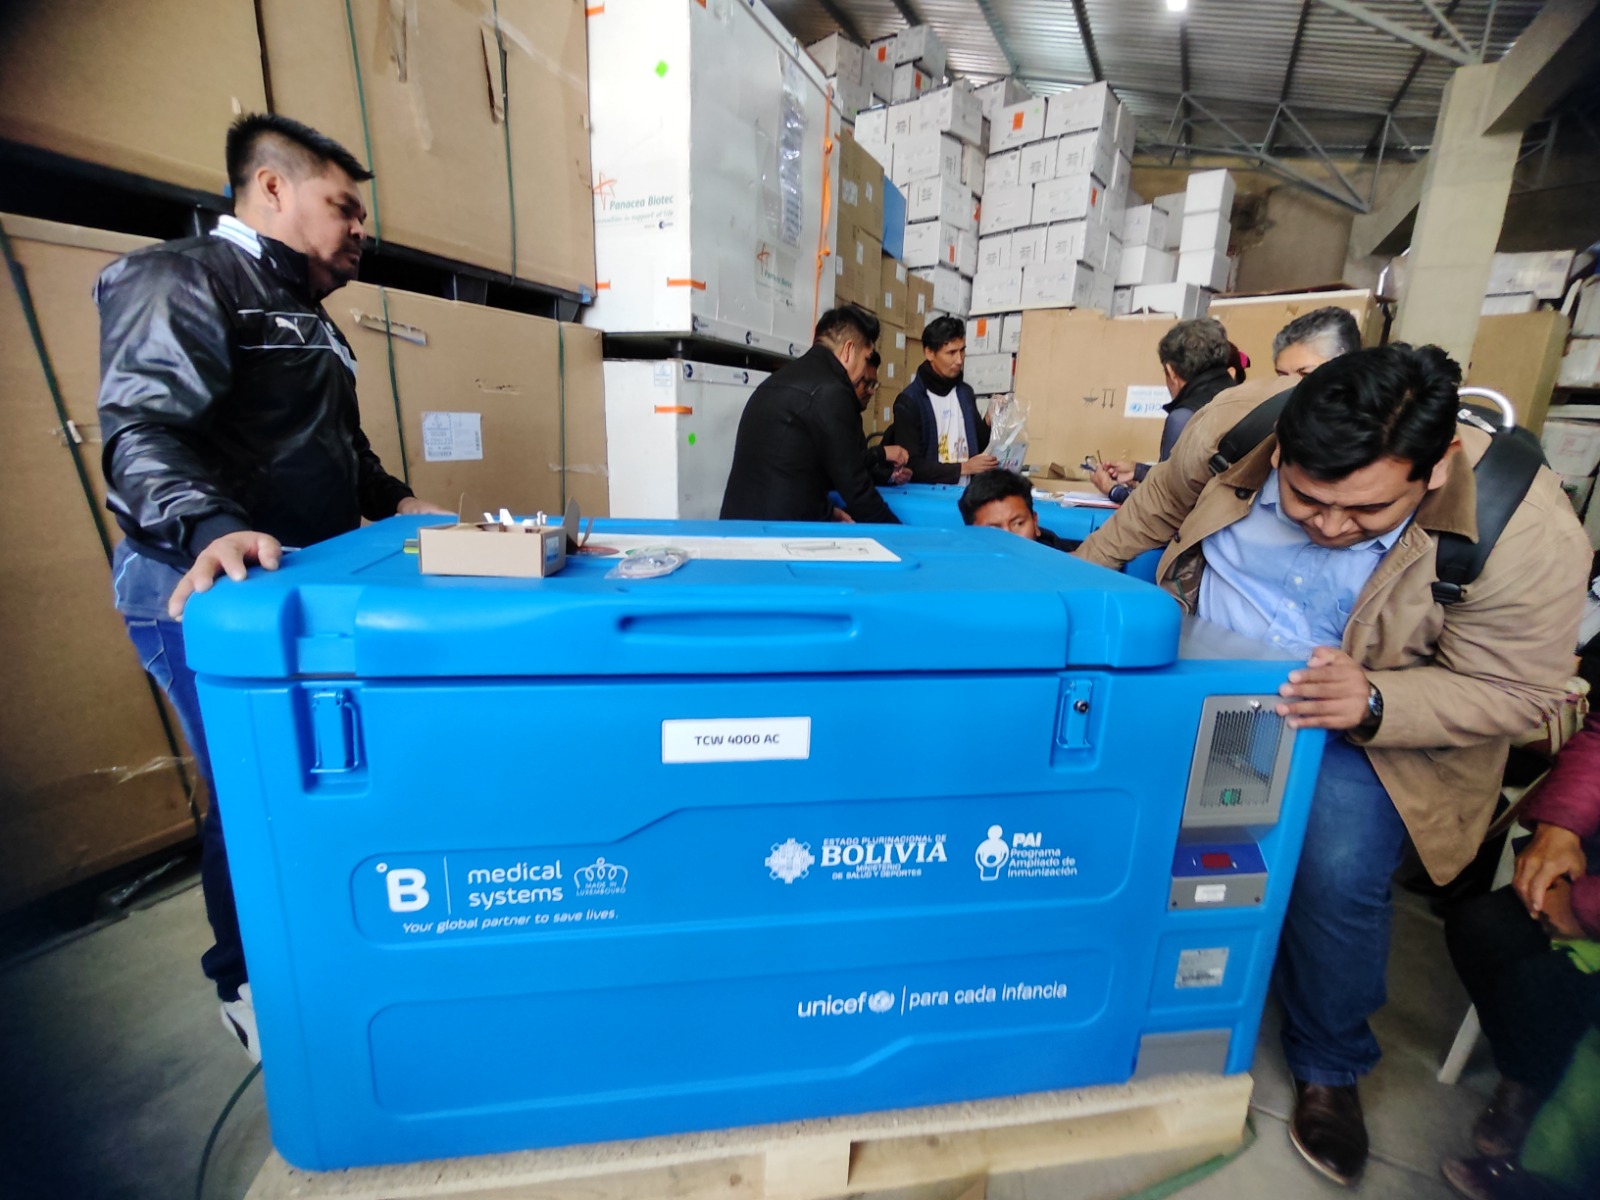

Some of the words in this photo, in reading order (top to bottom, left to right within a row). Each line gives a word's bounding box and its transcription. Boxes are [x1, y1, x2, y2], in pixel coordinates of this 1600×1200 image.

[609, 199, 645, 210] Panacea
[648, 195, 674, 206] Biotec
[694, 735, 723, 746] TCW
[727, 734, 760, 745] 4000
[764, 733, 780, 744] AC
[823, 837, 858, 846] ESTADO
[861, 835, 933, 845] PLURINACIONAL
[935, 834, 947, 842] DE
[1012, 832, 1042, 847] PAI
[820, 842, 947, 867] BOLIVIA
[1010, 848, 1061, 858] Programa
[856, 863, 901, 872] MINISTERIO
[1009, 857, 1060, 868] Ampliado
[1062, 856, 1076, 866] de
[468, 860, 563, 884] medical
[832, 872, 843, 880] DE
[846, 871, 872, 879] SALUD
[880, 869, 922, 878] DEPORTES
[469, 886, 564, 910] systems
[403, 922, 434, 933] Your
[436, 917, 478, 934] global
[481, 915, 531, 930] partner
[535, 914, 550, 924] to
[553, 911, 583, 923] save
[586, 908, 619, 920] lives.
[909, 990, 949, 1011] para
[954, 984, 997, 1005] cada
[1002, 980, 1067, 1001] infancia
[798, 991, 867, 1017] unicef
